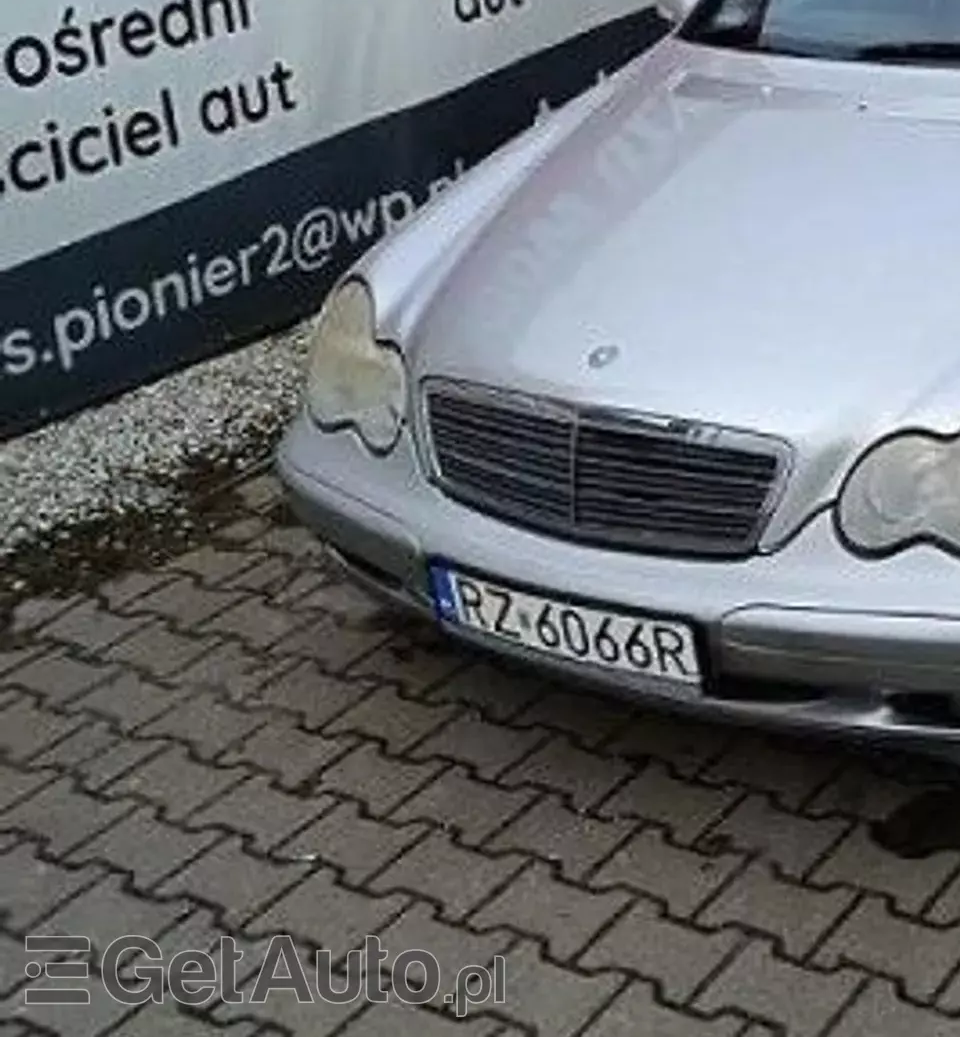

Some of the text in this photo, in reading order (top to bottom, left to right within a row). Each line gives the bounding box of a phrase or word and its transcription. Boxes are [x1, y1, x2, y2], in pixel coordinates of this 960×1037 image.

[0, 61, 297, 194] ciciel aut
[457, 580, 690, 675] RZ 6066R
